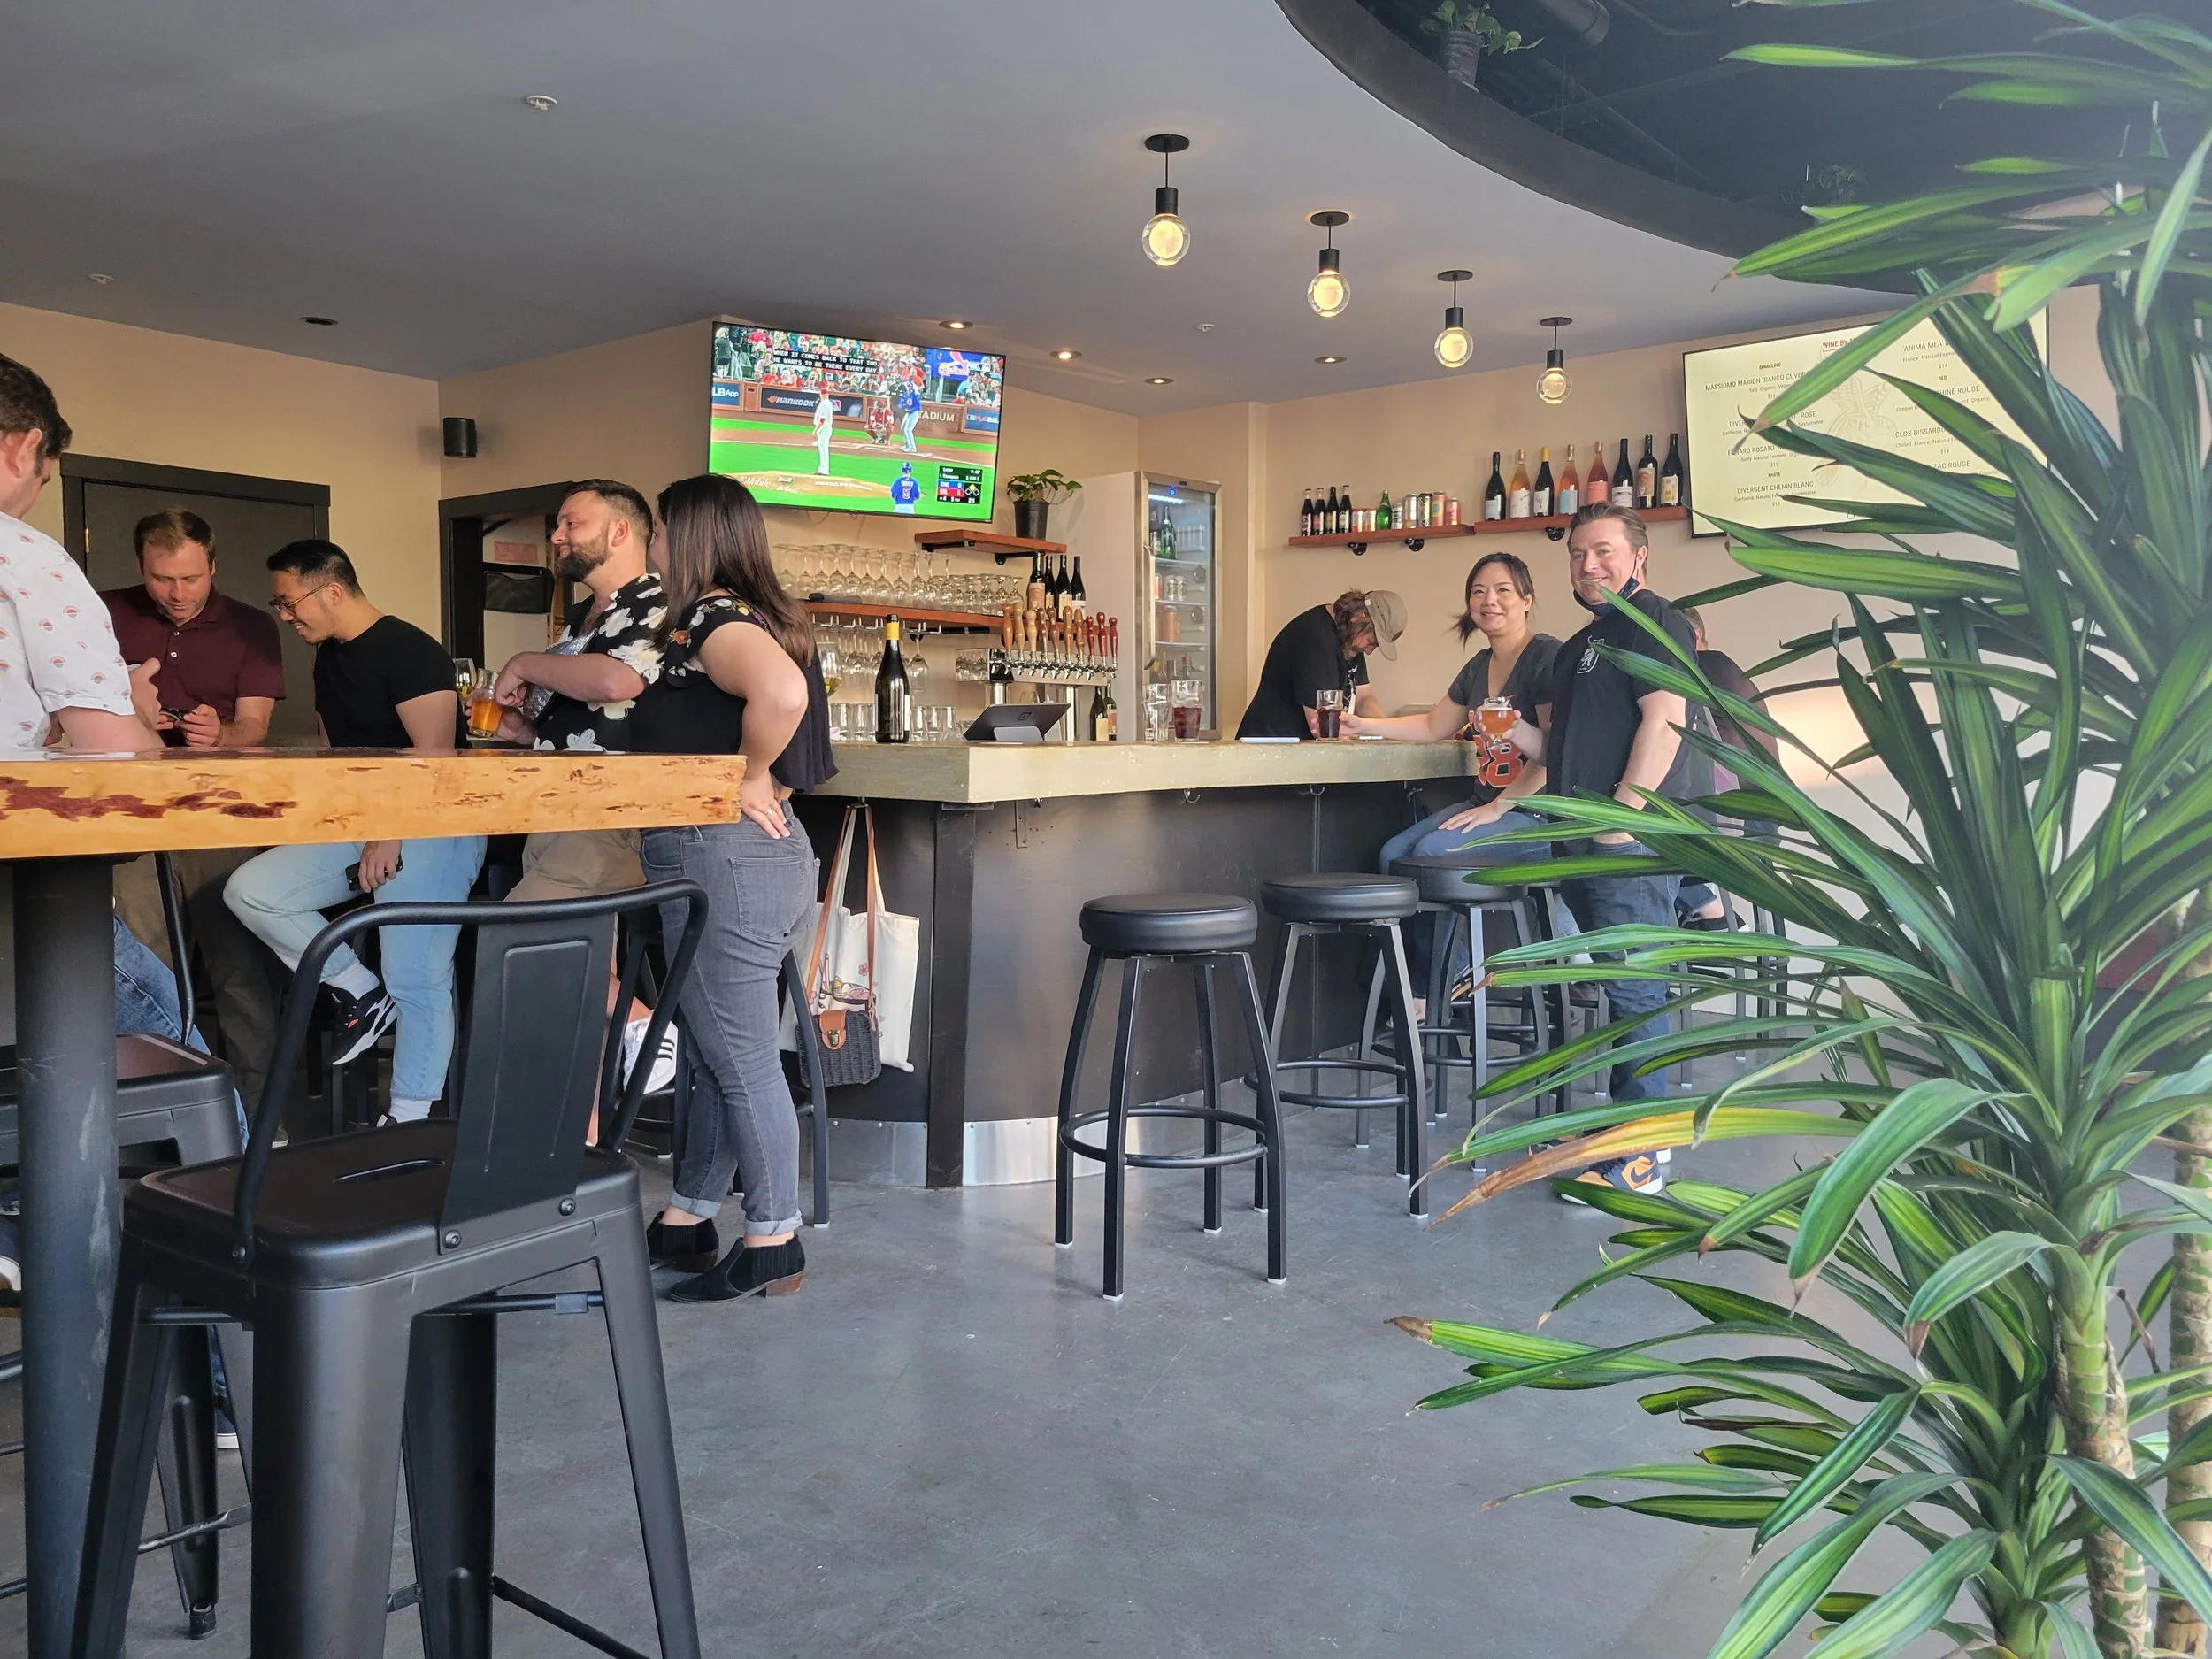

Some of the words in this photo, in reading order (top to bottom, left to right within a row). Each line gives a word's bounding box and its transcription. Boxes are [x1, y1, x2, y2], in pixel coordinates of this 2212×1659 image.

[1822, 340, 1839, 349] WINE
[1839, 338, 1847, 347] BY
[1737, 377, 1761, 387] MARION
[1762, 374, 1785, 384] BIANCO
[726, 388, 739, 398] App
[1957, 384, 1980, 395] ROUGE
[918, 410, 955, 422] TADIUM
[1947, 460, 1971, 469] ROUGE
[1737, 485, 1769, 495] DIVERGENT
[1770, 482, 1793, 491] CHENIN
